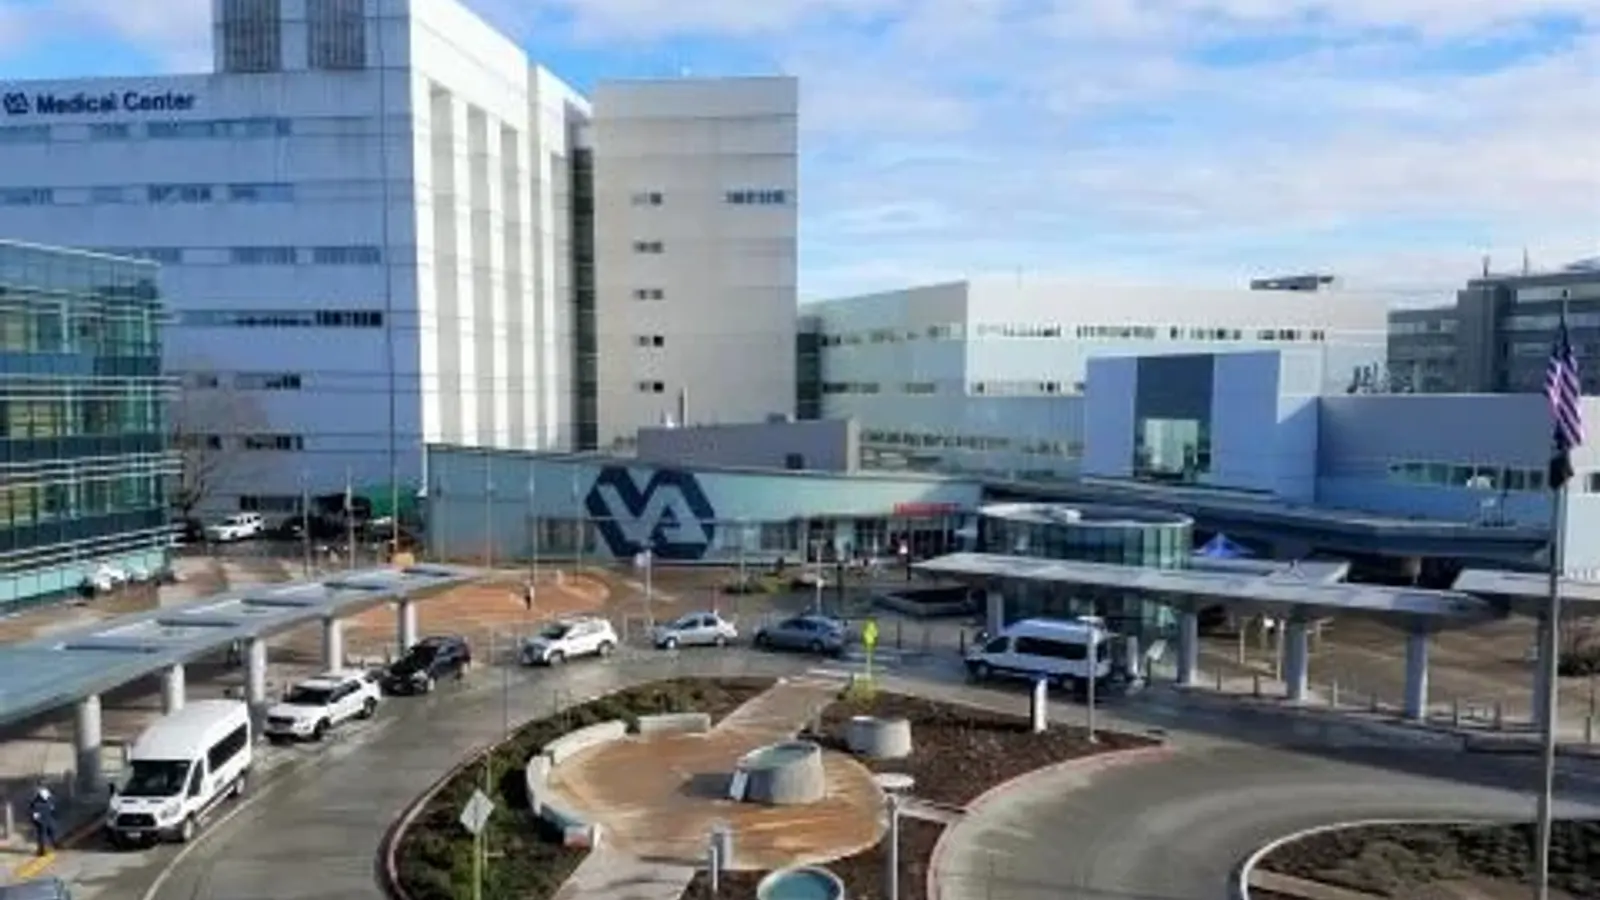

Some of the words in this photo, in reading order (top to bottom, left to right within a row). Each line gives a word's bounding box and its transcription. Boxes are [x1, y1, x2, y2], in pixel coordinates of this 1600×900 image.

[37, 93, 116, 113] Medical
[123, 92, 194, 111] Center
[587, 471, 713, 556] VA
